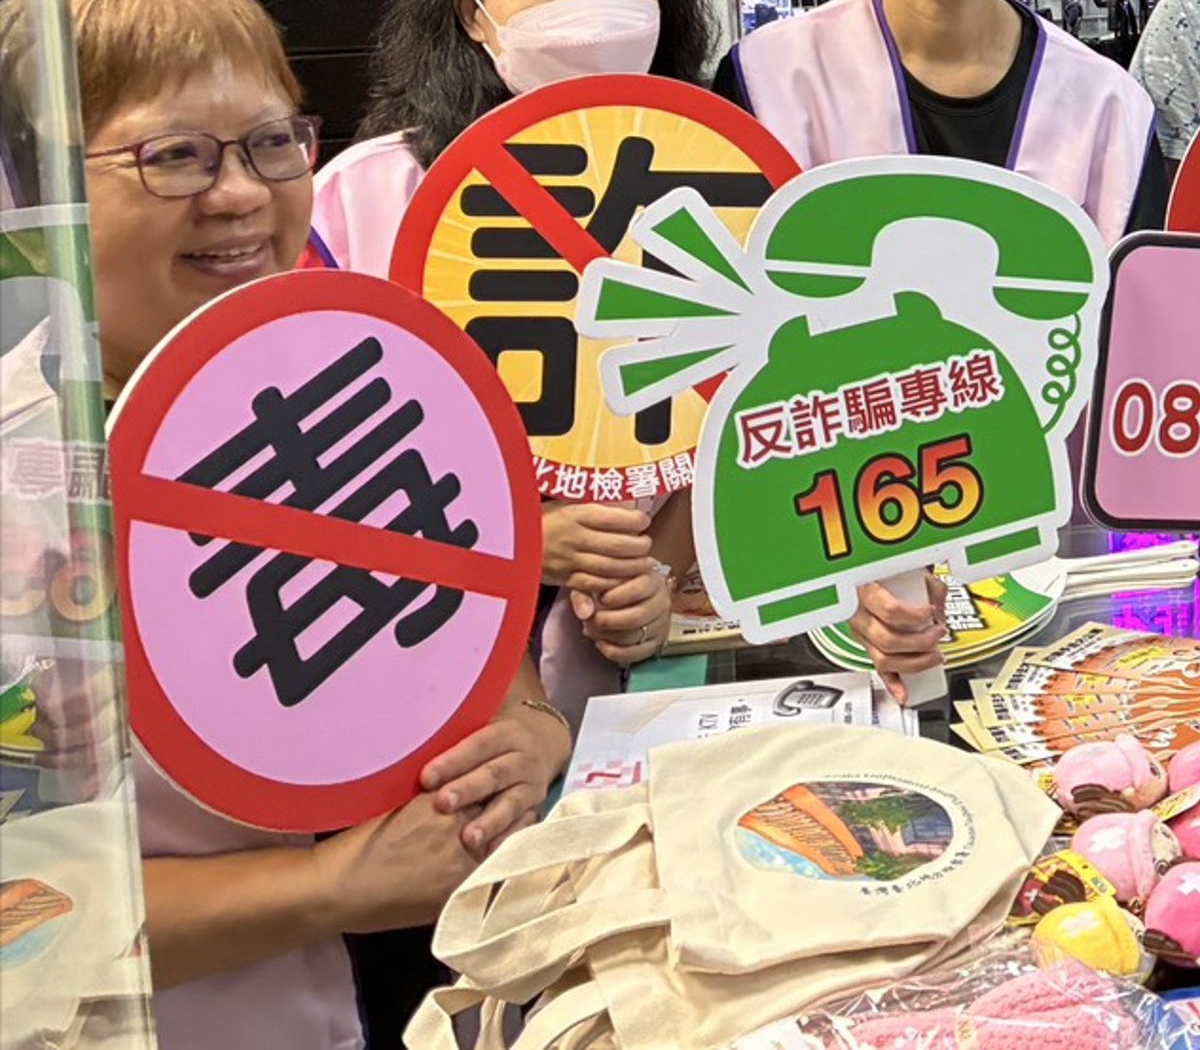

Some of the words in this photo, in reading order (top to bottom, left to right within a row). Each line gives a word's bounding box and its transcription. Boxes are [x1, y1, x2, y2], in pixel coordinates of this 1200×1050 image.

[739, 352, 1003, 465] 反詐騙專線
[794, 432, 985, 562] 165
